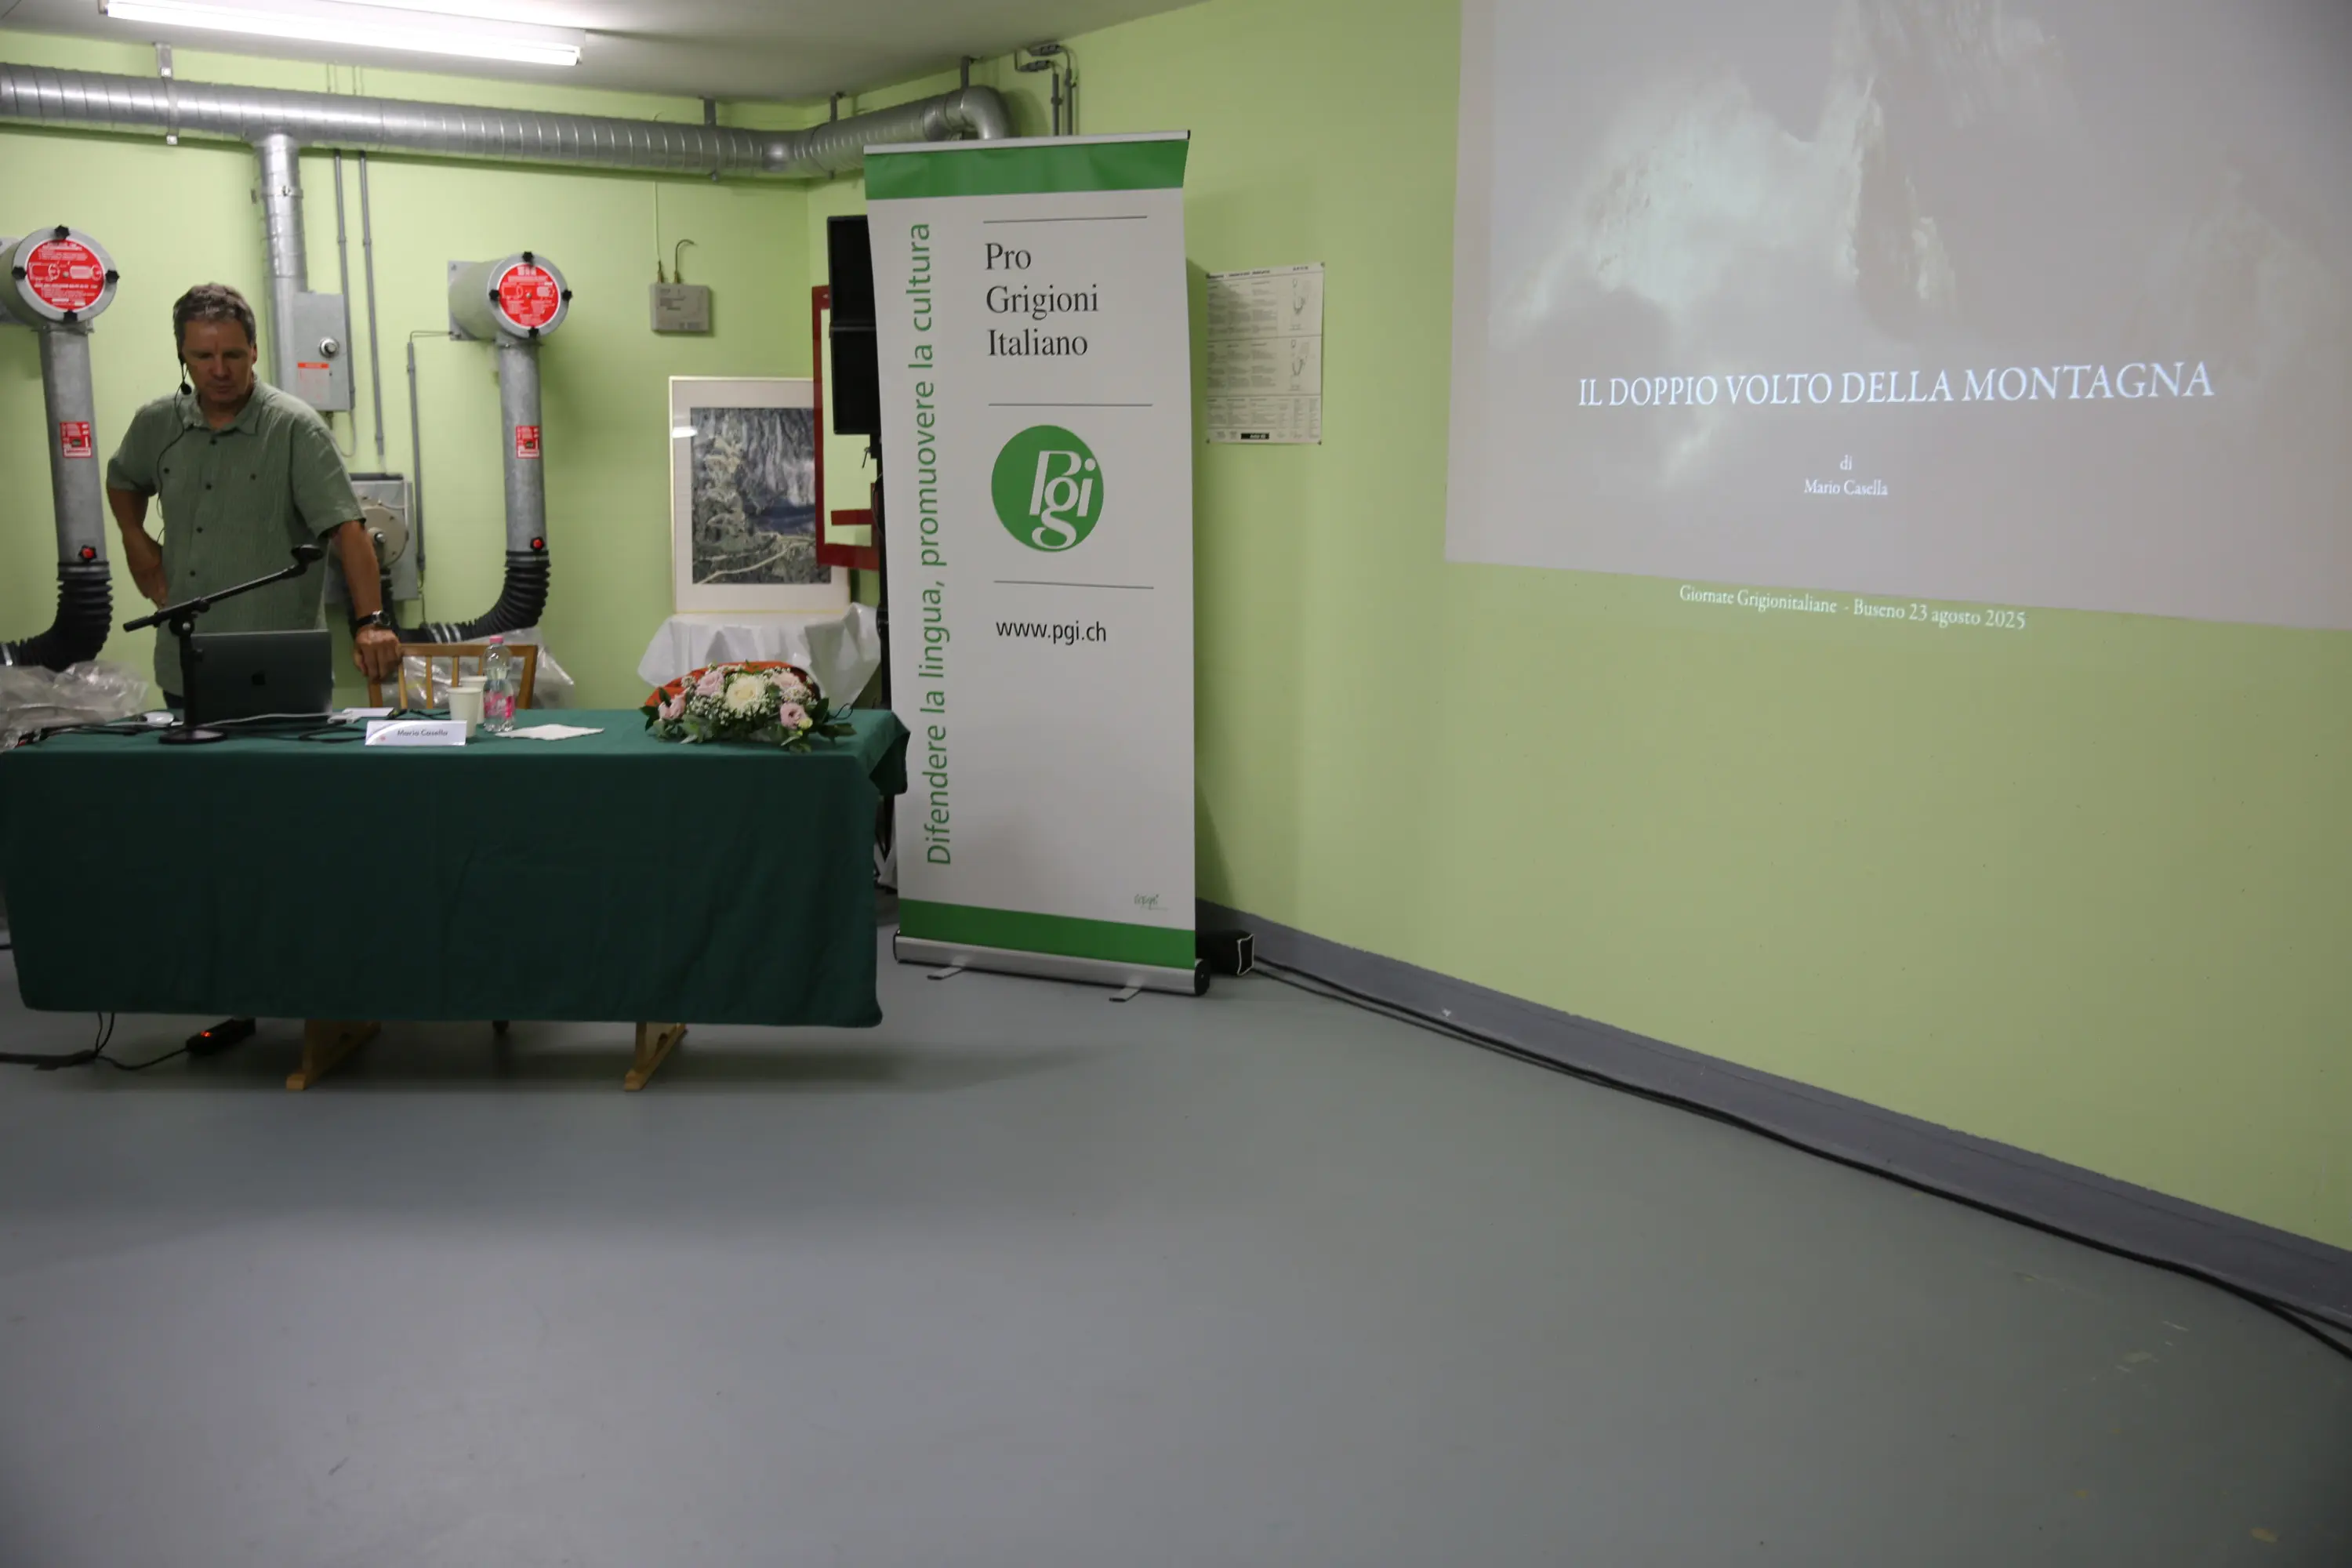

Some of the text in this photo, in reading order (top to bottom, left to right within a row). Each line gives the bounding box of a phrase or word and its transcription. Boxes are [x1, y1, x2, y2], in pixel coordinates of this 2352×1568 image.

[985, 242, 1032, 270] Pro
[985, 283, 1098, 321] Grigioni
[987, 328, 1088, 357] Italiano
[1578, 361, 2216, 406] IL DOPPIO VOLTO DELLA MONTAGNA
[1839, 454, 1853, 471] di
[1803, 479, 1889, 496] Mario Casella
[906, 223, 951, 866] Difendere la lingua, promuovere la cultura
[1679, 585, 1735, 605] Giornate
[1737, 590, 1838, 614] Grigionitaliane
[1853, 598, 1906, 619] Buseno
[1908, 603, 1928, 622] 23
[1931, 610, 1982, 629] agosto
[1984, 609, 2026, 630] 2025
[995, 619, 1107, 646] www.pgi.ch
